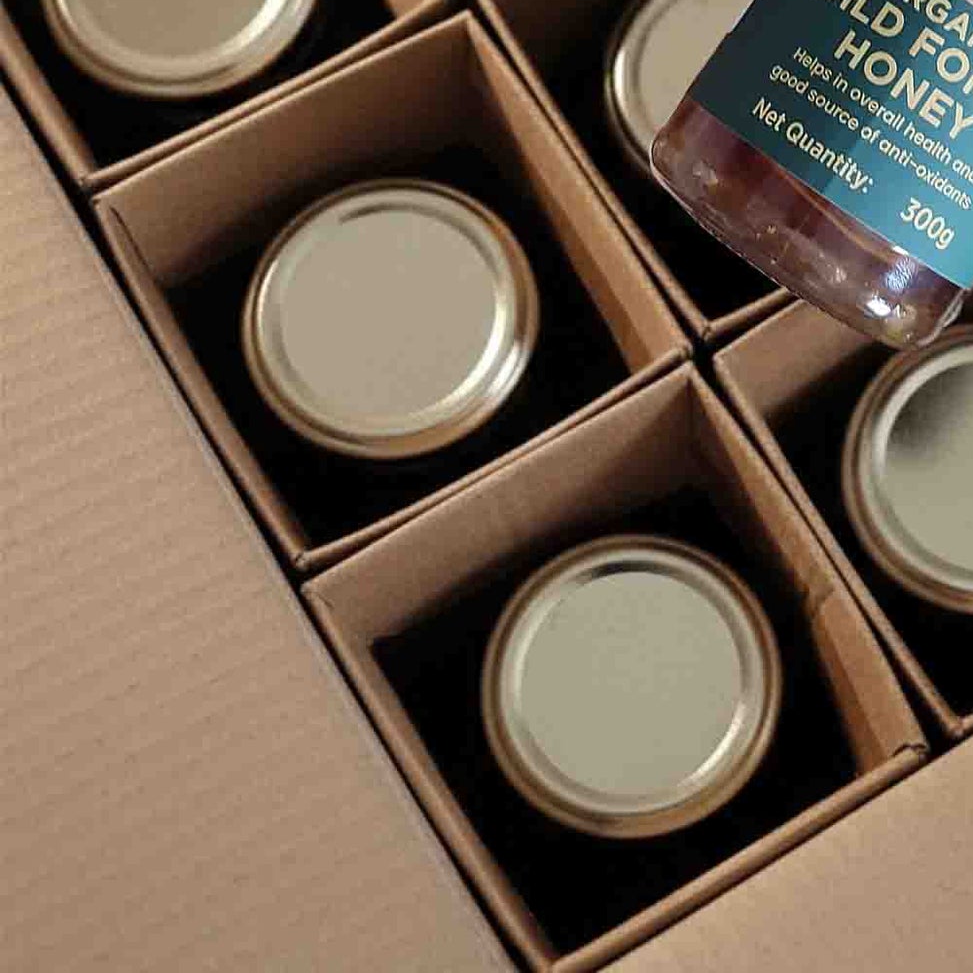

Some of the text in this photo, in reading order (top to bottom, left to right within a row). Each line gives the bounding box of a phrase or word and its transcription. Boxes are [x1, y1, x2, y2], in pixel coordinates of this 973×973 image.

[752, 97, 874, 194] Net Quantity:
[769, 65, 973, 210] good source of anti-oxidants
[793, 46, 833, 81] Helps
[832, 72, 849, 93] in
[850, 87, 905, 131] overall
[903, 121, 952, 165] health
[900, 197, 955, 250] 300g
